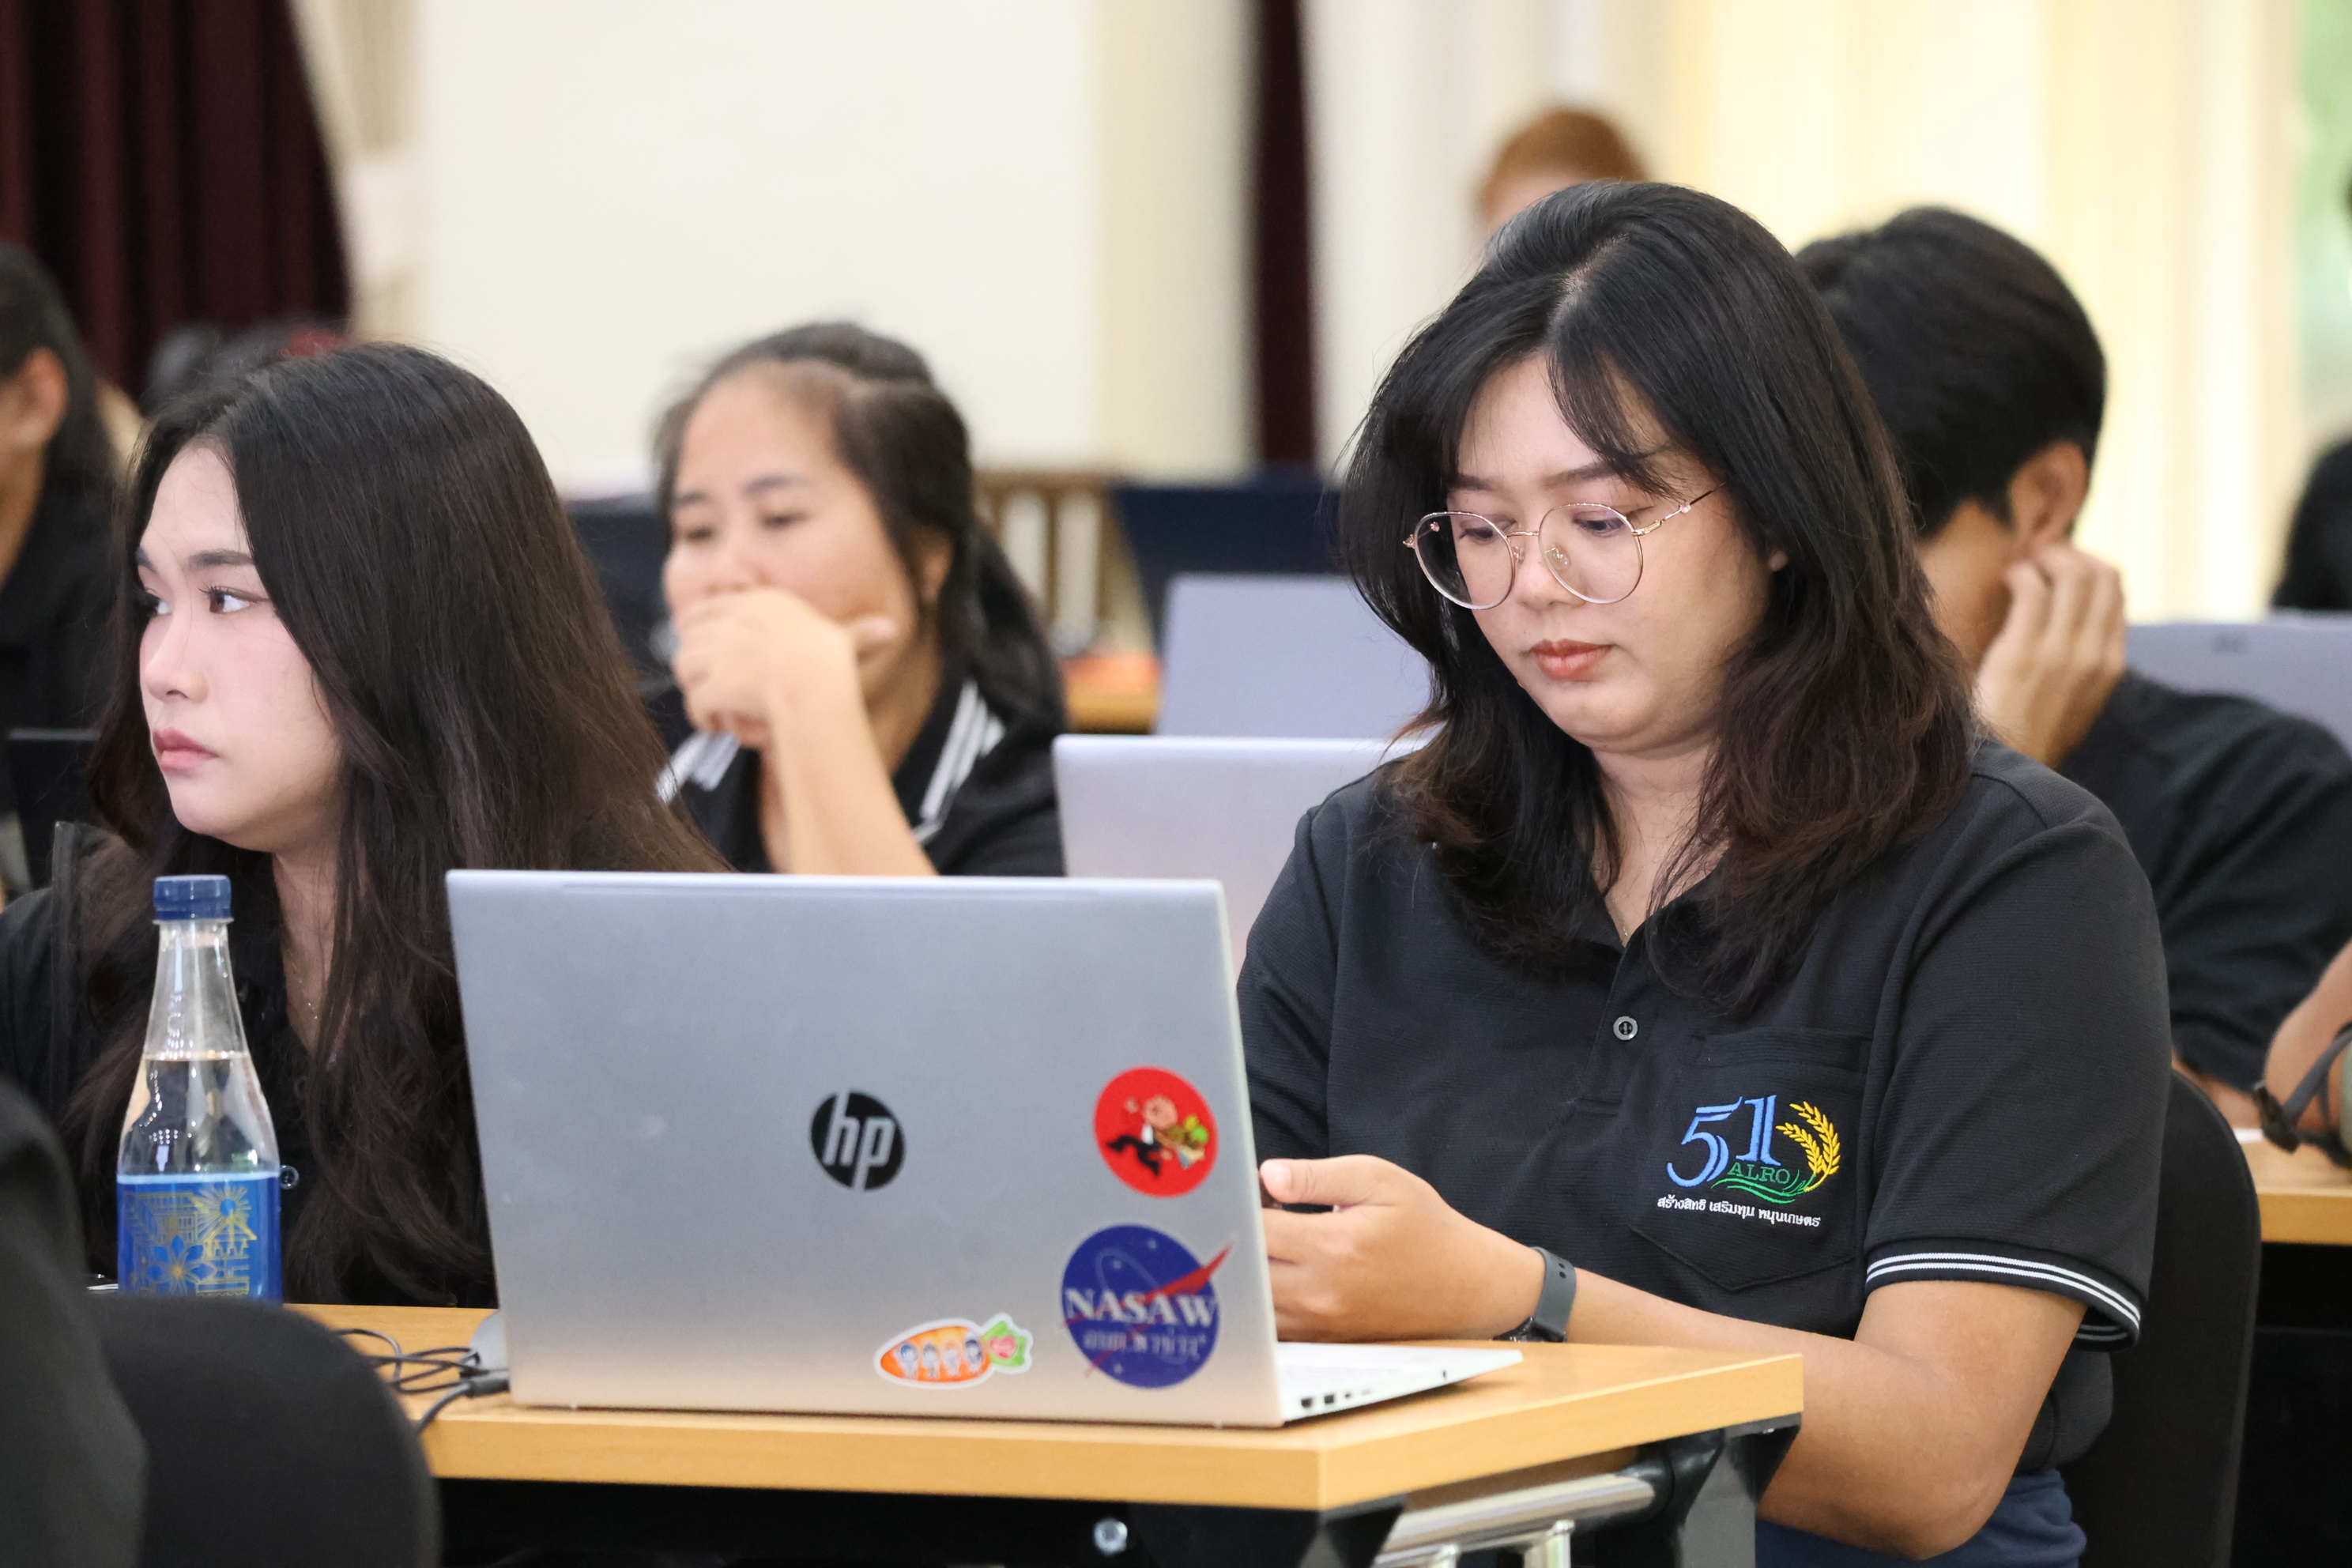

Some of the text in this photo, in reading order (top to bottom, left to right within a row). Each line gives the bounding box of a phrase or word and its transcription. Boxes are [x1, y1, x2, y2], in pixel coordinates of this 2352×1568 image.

[822, 1090, 897, 1191] hp
[1667, 1095, 1781, 1187] 51
[1727, 1162, 1791, 1185] ALRO
[1657, 1194, 1821, 1227] สร้างสิทธิ เสริมทุน หนุนเกษตร
[1065, 1287, 1218, 1326] NASAW
